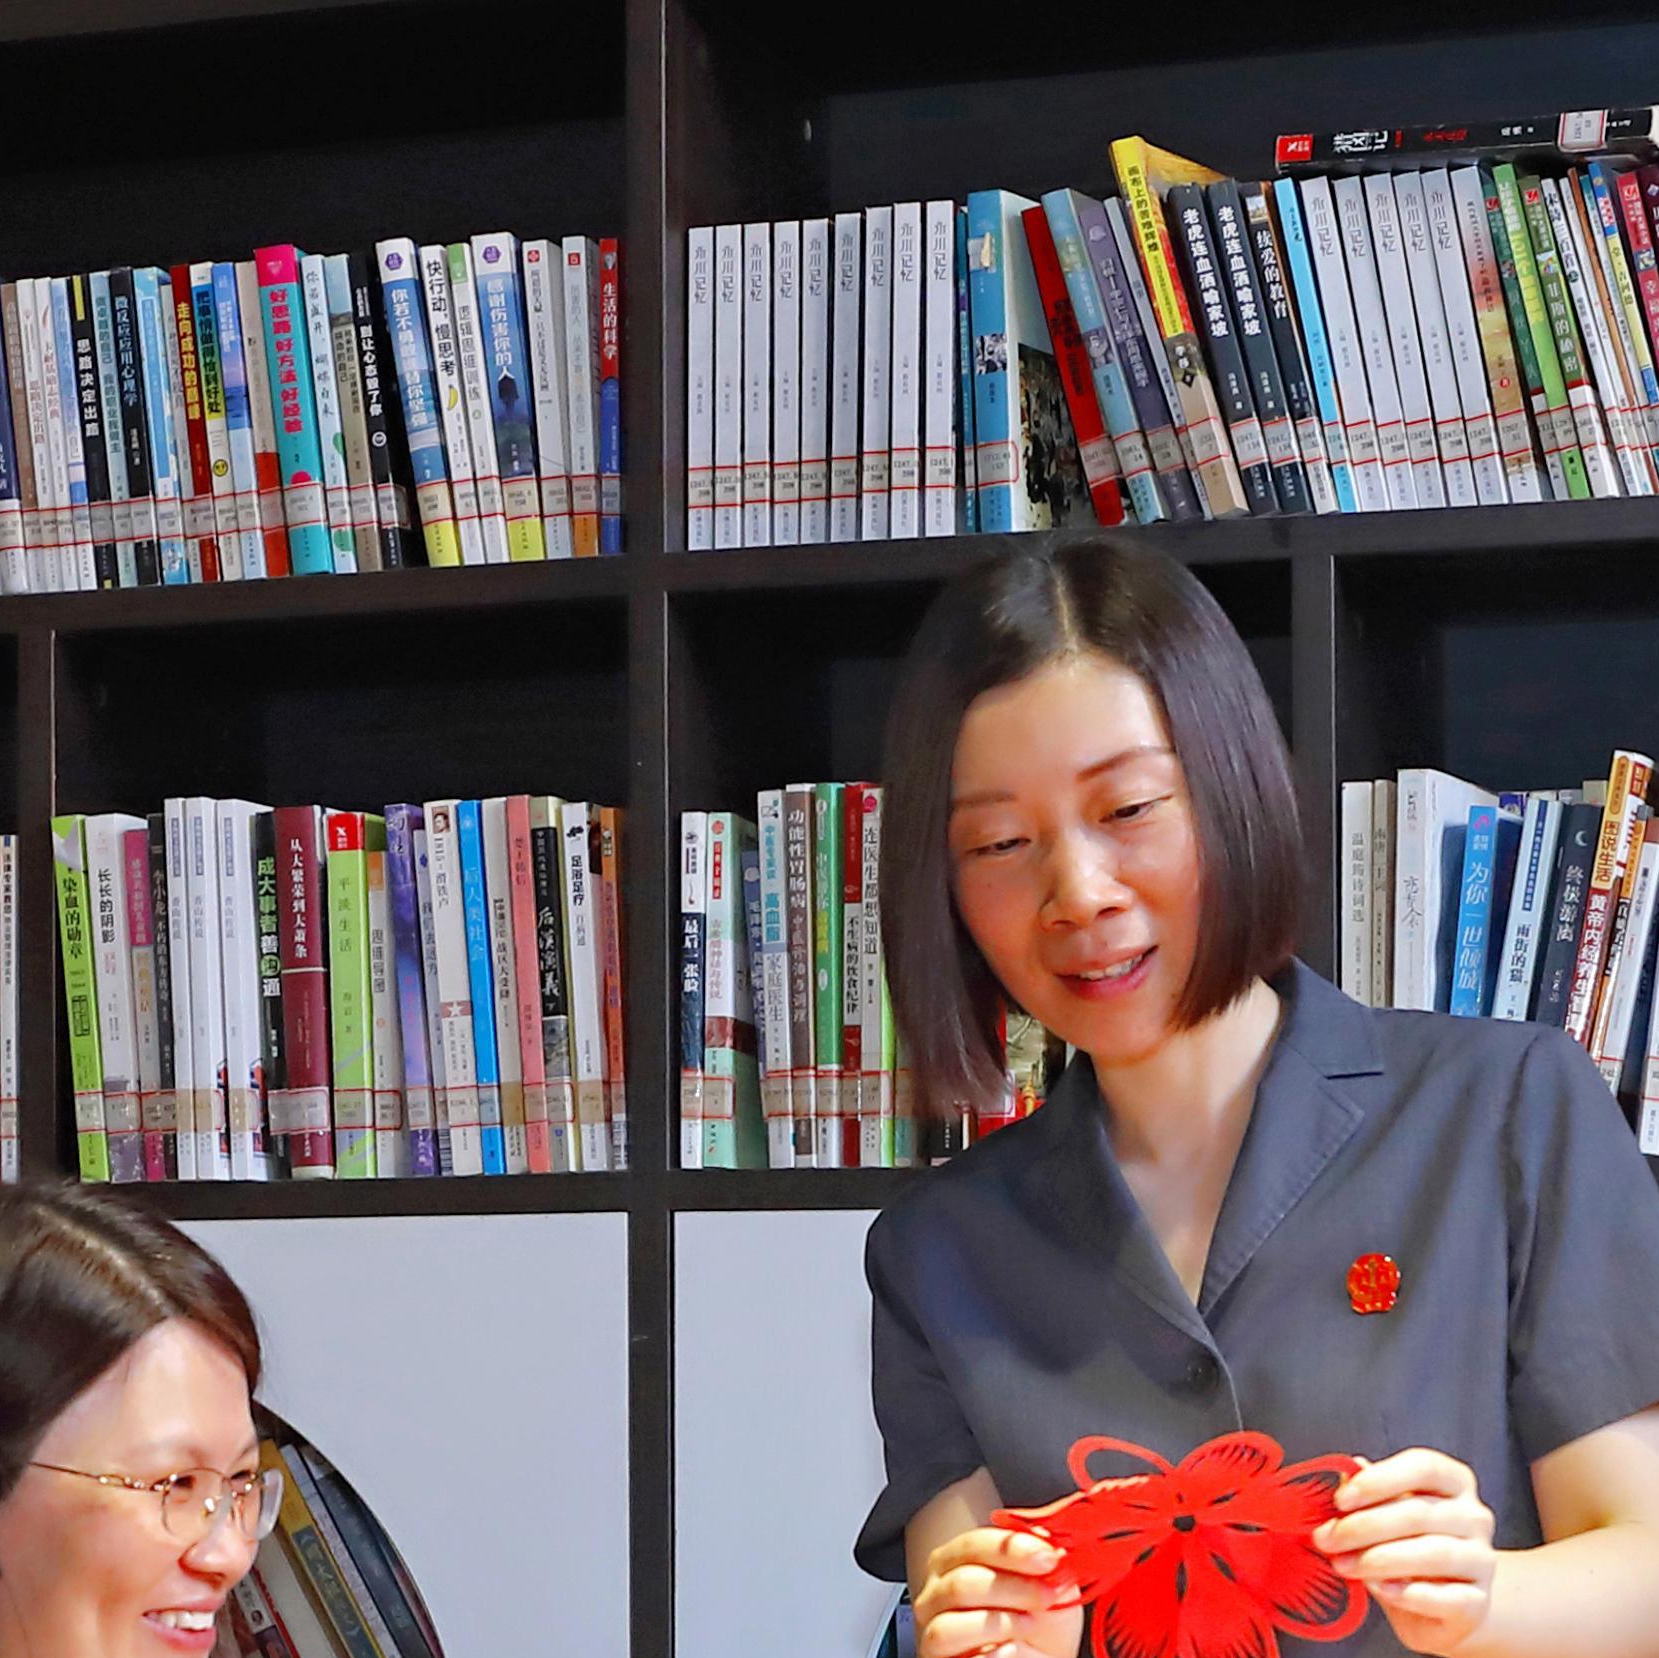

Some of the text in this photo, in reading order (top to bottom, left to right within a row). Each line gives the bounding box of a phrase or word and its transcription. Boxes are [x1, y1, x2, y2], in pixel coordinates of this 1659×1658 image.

[268, 288, 292, 334] 好思路
[486, 278, 516, 381] 感谢伤害你的人
[602, 281, 620, 360] 生活的科学
[76, 338, 100, 438] 思路决定出路
[274, 338, 298, 384] 好方法
[787, 809, 807, 909] 功能性胃肠病
[862, 826, 880, 956] 连医生都想知道
[62, 875, 83, 961] 染血的勋章
[97, 867, 116, 945] 长长的阴影
[1457, 861, 1491, 991] 为你一世倾城
